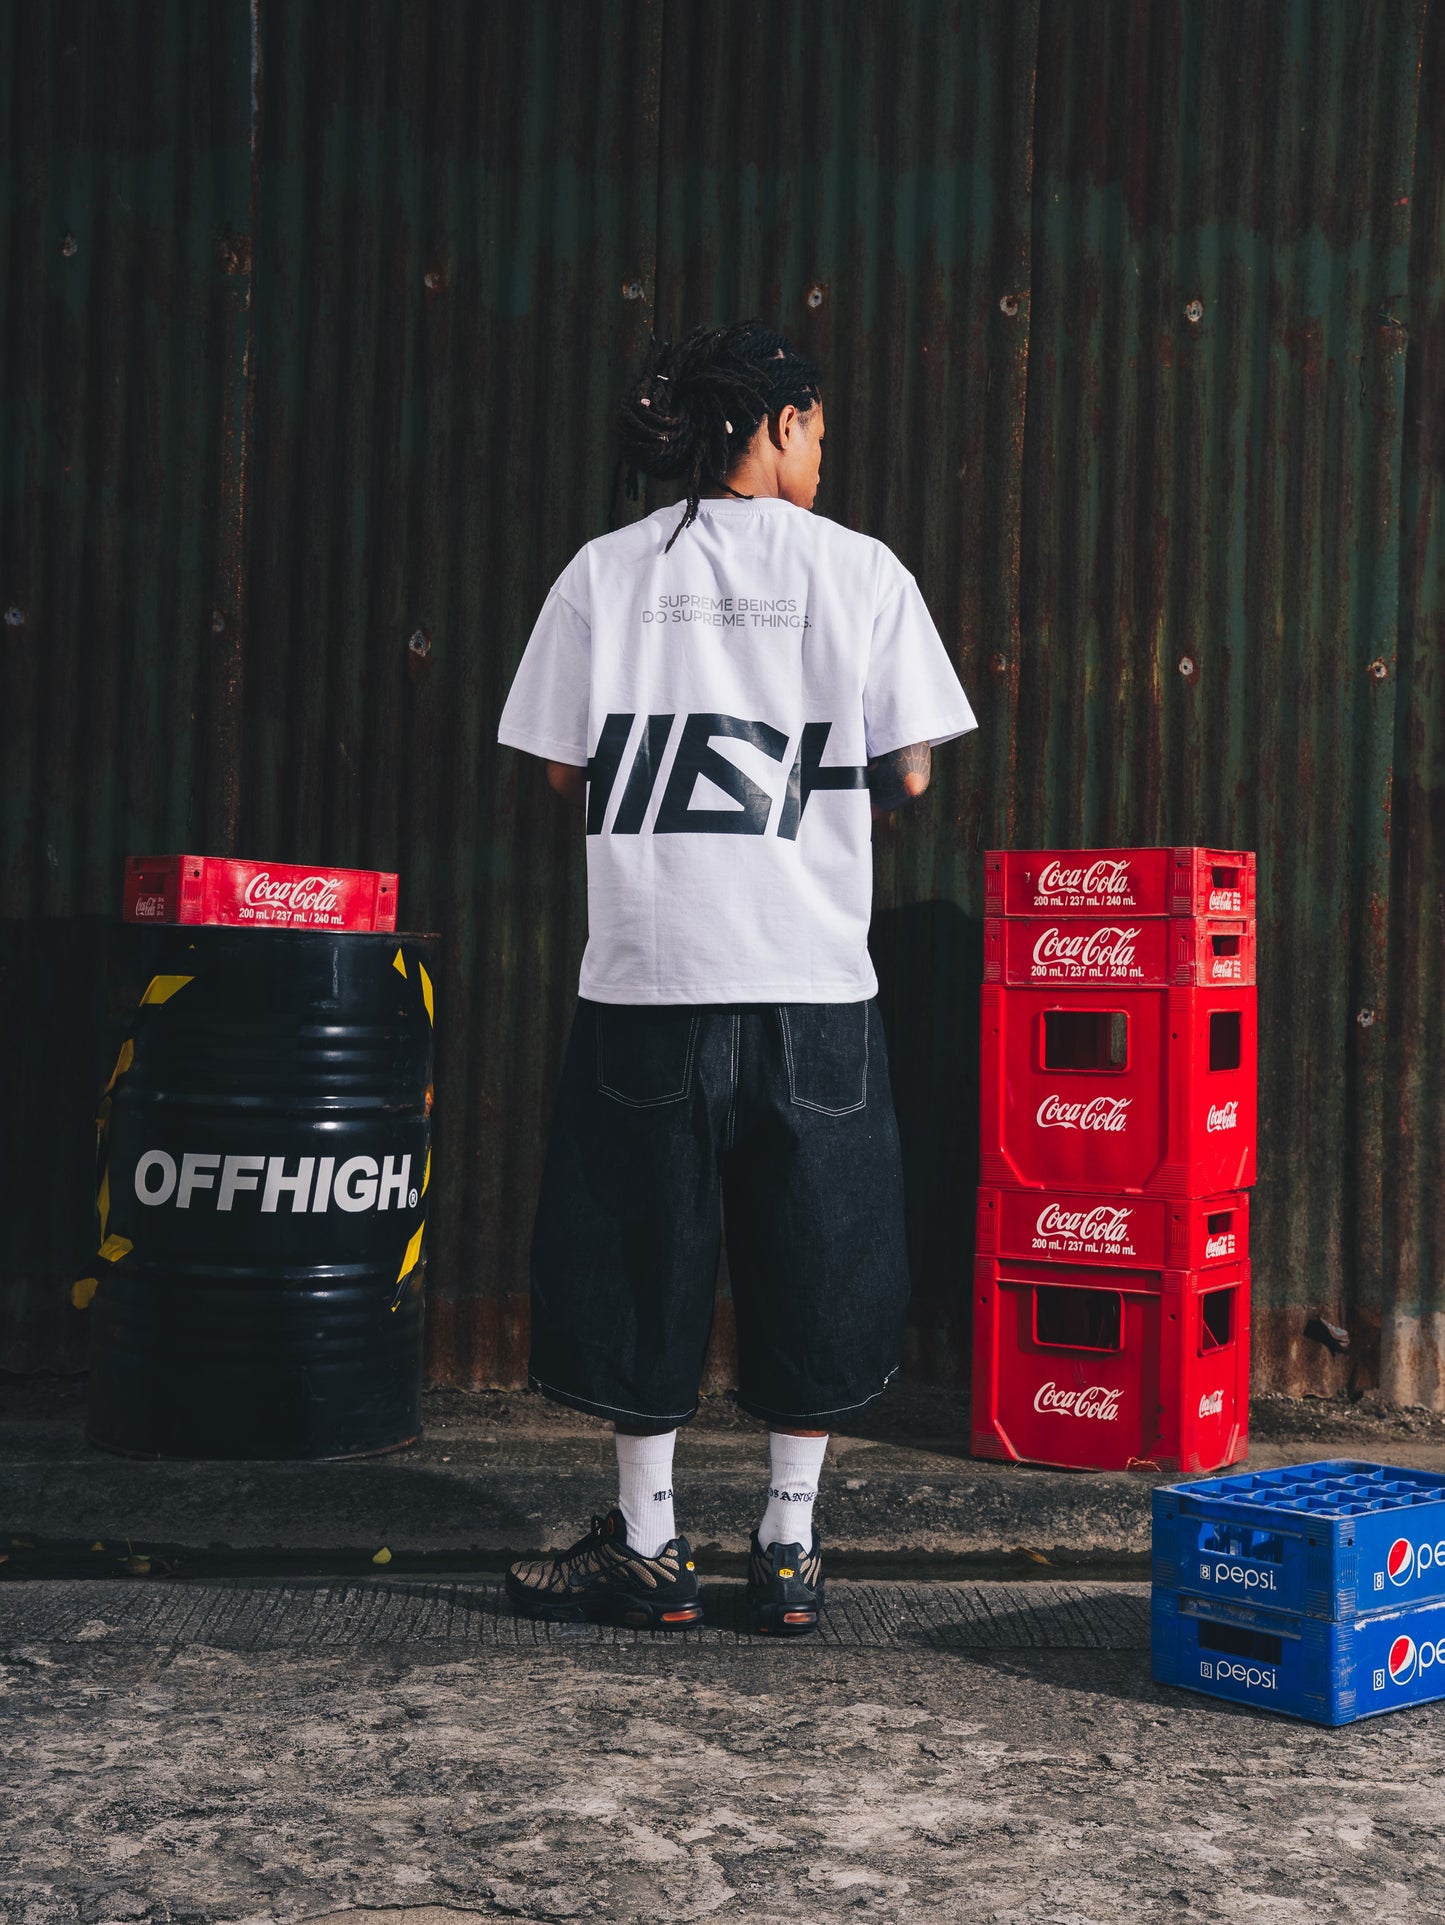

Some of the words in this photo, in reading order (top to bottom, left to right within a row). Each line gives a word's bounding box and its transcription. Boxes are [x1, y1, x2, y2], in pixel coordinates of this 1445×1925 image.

[658, 594, 733, 612] SUPREME
[738, 598, 797, 612] BEINGS
[642, 610, 667, 624] DO
[672, 610, 745, 627] SUPREME
[750, 613, 812, 629] THINGS.
[1038, 859, 1132, 895] Coca-Cola
[244, 872, 344, 911] Coca-Cola
[1033, 895, 1048, 906] 200
[1050, 895, 1064, 906] mL
[1069, 895, 1085, 906] 237
[1086, 895, 1100, 906] mL
[1106, 895, 1121, 906] 240
[1123, 895, 1136, 906] mL
[239, 907, 254, 919] 200
[256, 909, 270, 919] mL
[276, 911, 292, 921] 237
[294, 912, 307, 922] mL
[331, 915, 345, 924] mL
[1032, 927, 1142, 966] Coca-Cola
[1031, 965, 1047, 977] 200
[1049, 965, 1064, 977] mL
[1070, 965, 1087, 977] 237
[1089, 965, 1104, 977] mL
[1110, 965, 1127, 977] 240
[1129, 965, 1144, 977] mL
[1036, 1094, 1133, 1131] Coca-Cola
[1036, 1203, 1133, 1241] Coca-Cola
[1032, 1238, 1047, 1249] 200
[1048, 1239, 1062, 1250] mL
[1068, 1240, 1083, 1251] 237
[1085, 1242, 1099, 1253] mL
[1105, 1243, 1120, 1254] 240
[1122, 1245, 1136, 1255] mL
[1033, 1381, 1124, 1420] Coca-Cola
[1215, 1563, 1275, 1590] pepsi
[1216, 1660, 1276, 1690] pepsi
